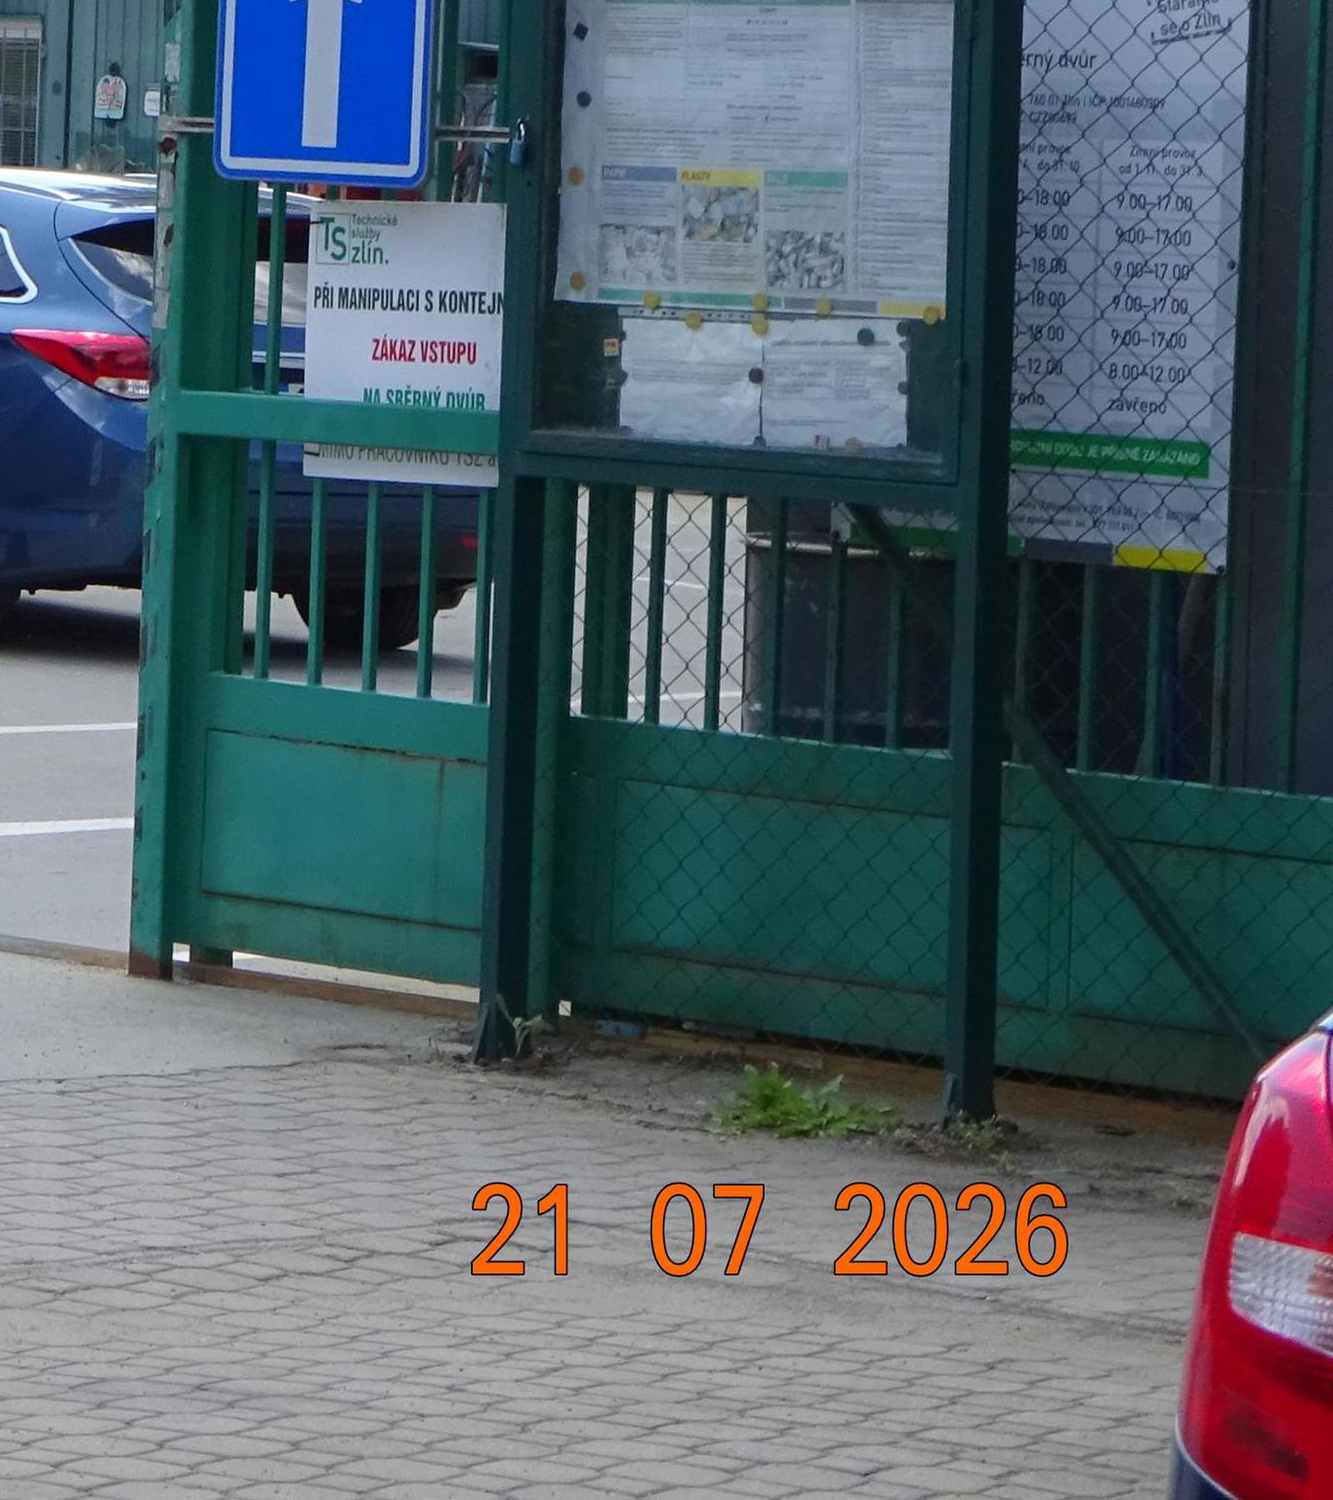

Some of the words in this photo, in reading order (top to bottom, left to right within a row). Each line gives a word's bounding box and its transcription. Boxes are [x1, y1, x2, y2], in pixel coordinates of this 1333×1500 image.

[352, 213, 398, 227] Technické
[320, 216, 347, 261] TS
[351, 226, 381, 241] služby
[351, 240, 389, 265] zlín.
[313, 282, 334, 309] PŘI
[338, 286, 420, 312] MANIPULACI
[425, 290, 434, 313] S
[372, 334, 416, 363] ZÁKAZ
[420, 340, 477, 365] VSTUPU
[363, 387, 381, 404] NA
